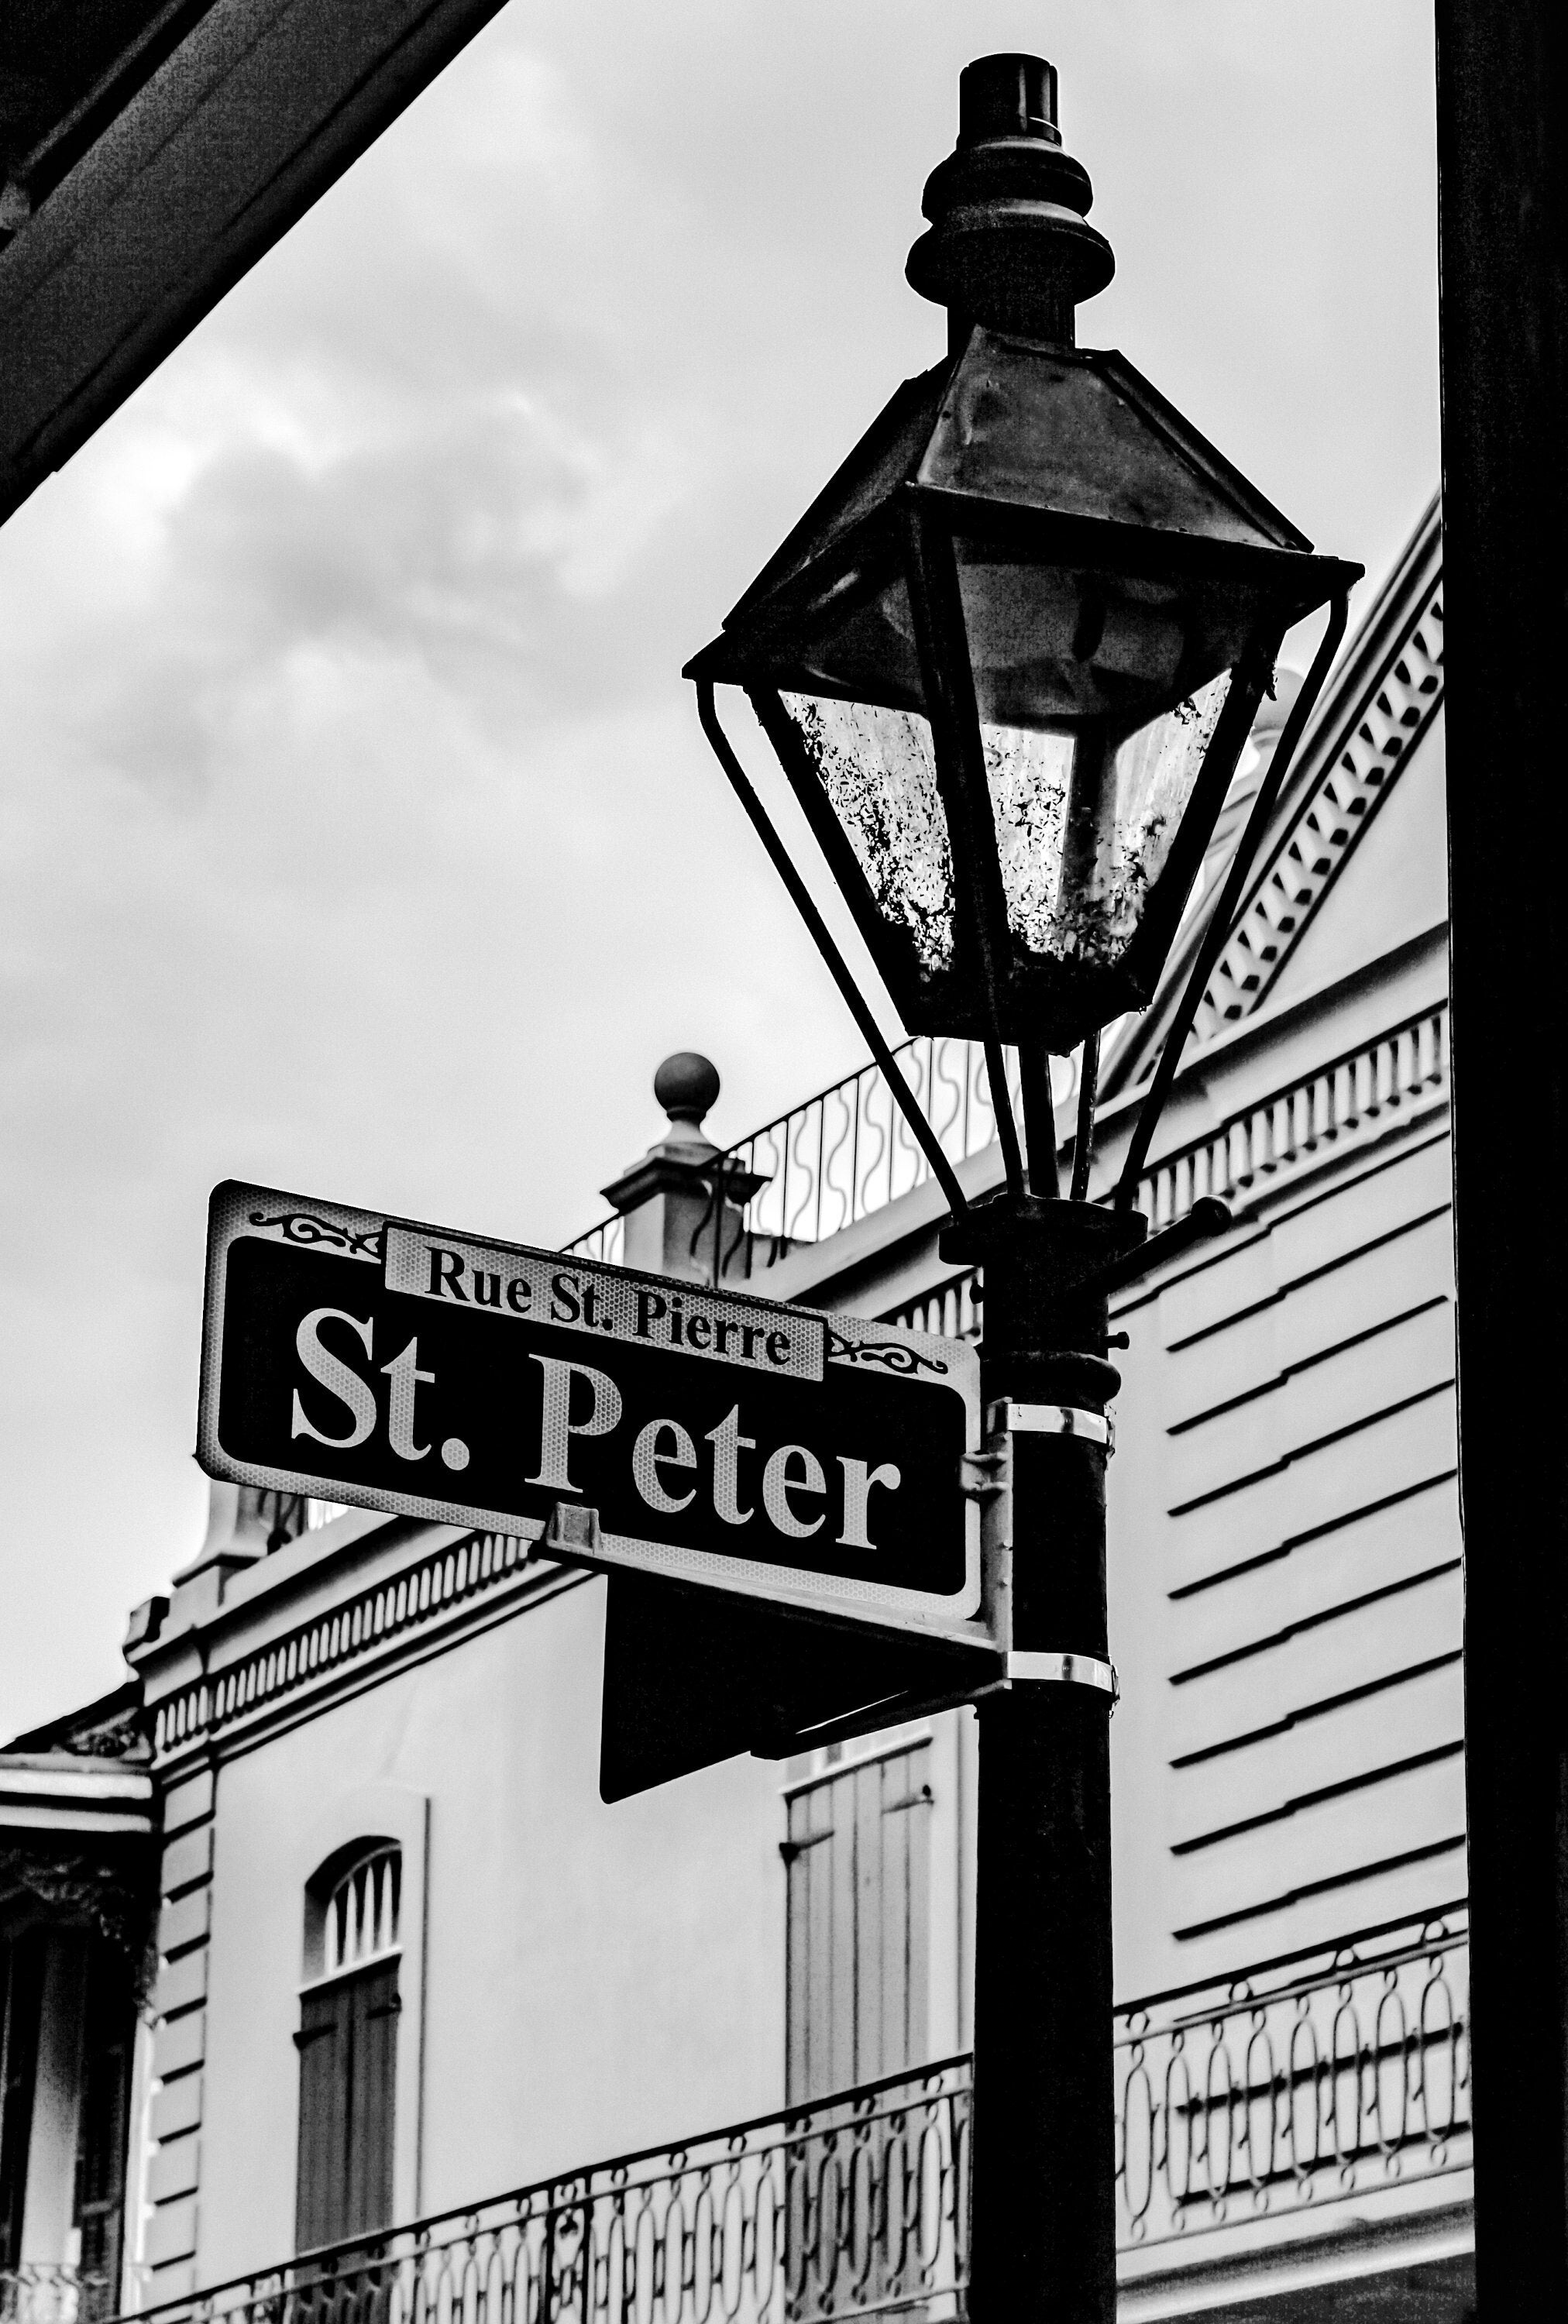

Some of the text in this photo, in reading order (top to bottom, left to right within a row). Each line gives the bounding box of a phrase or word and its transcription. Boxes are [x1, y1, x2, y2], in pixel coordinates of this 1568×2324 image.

[425, 1246, 791, 1366] Rue St. Pierre
[291, 1307, 901, 1549] St. Peter
